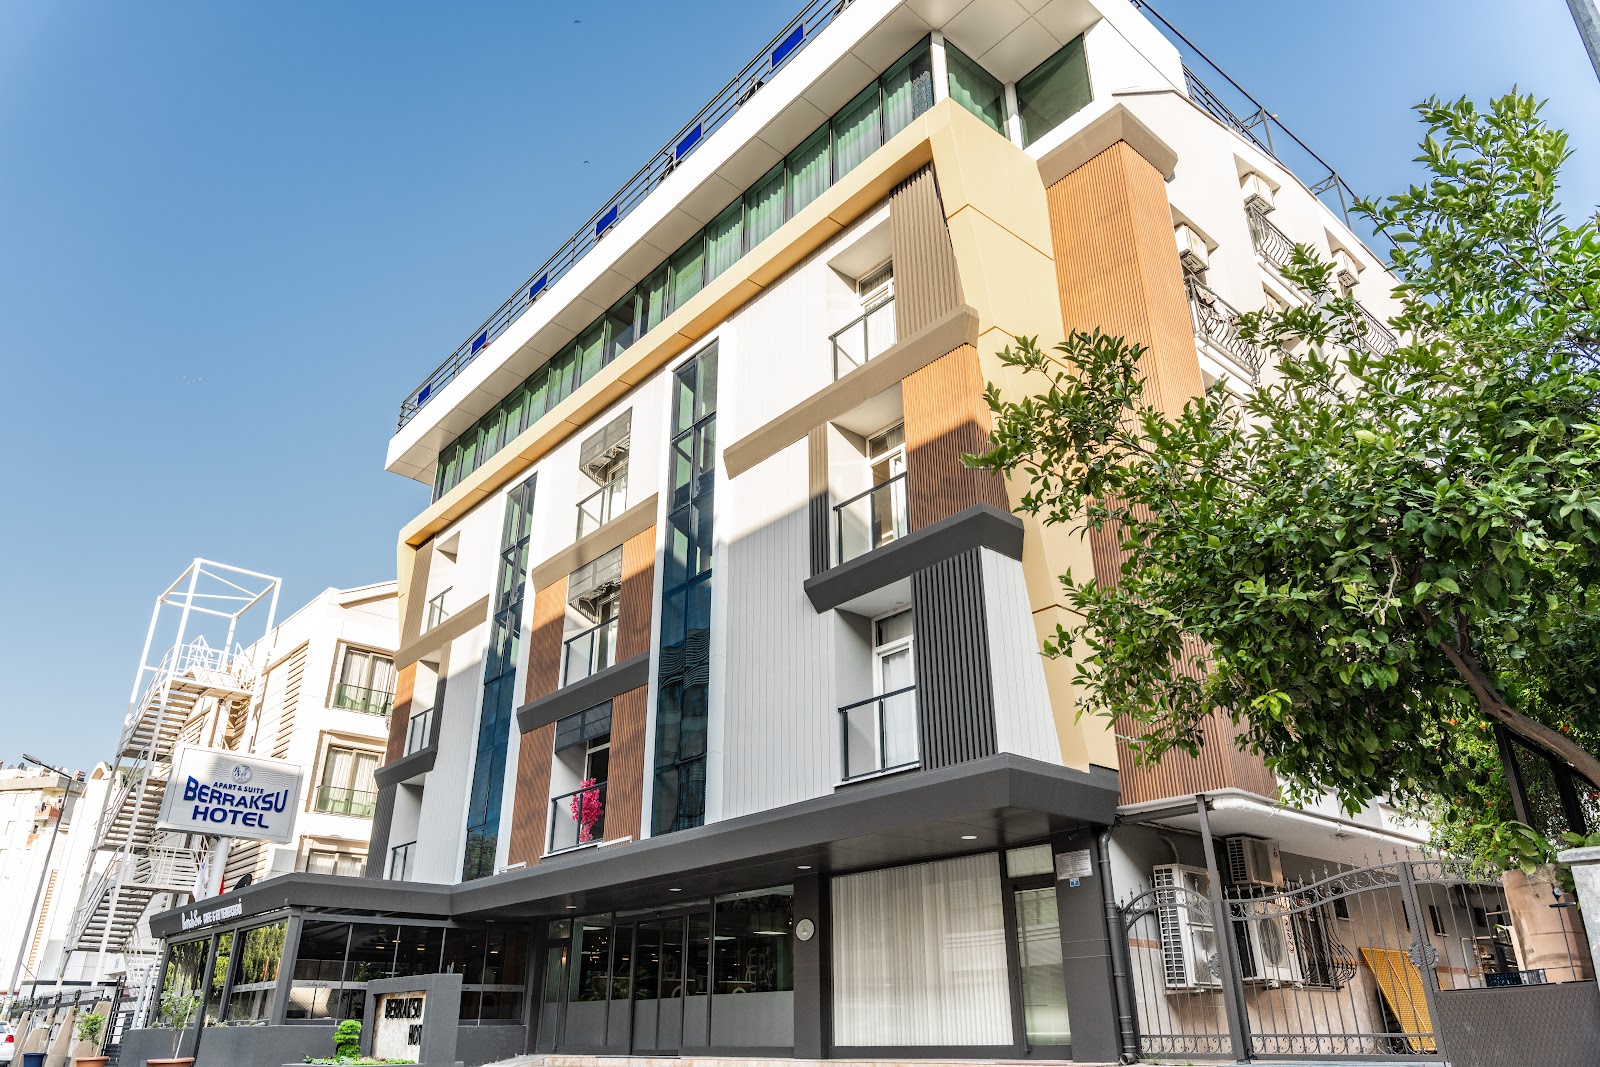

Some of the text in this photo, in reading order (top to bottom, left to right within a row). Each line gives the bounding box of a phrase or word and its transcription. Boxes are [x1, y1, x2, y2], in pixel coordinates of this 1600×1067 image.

[183, 775, 289, 813] BERRAKSU
[213, 781, 237, 791] APART
[244, 786, 265, 795] SUITE
[192, 805, 269, 829] HOTEL
[385, 998, 424, 1019] BERRAKSU
